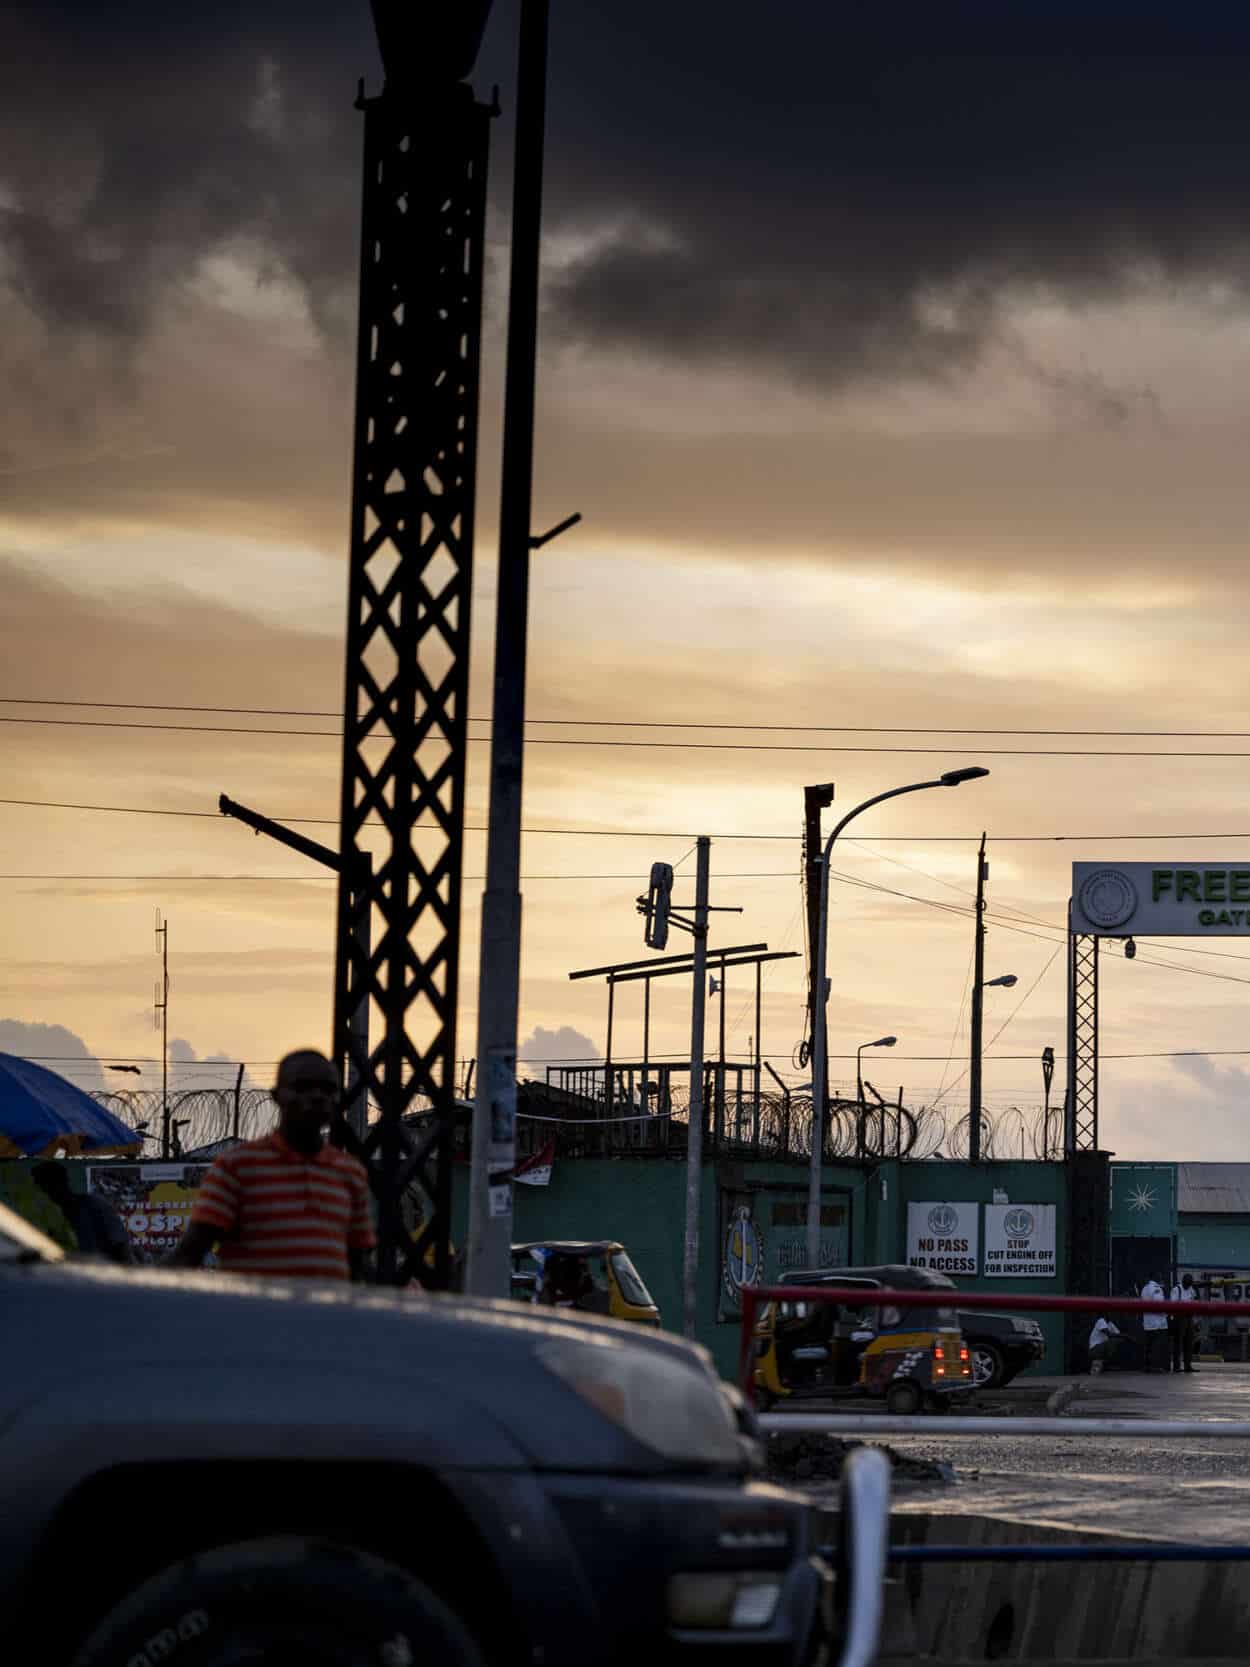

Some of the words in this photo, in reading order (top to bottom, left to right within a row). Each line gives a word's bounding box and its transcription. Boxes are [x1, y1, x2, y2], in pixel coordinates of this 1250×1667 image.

[121, 1214, 191, 1232] OSP
[918, 1238, 934, 1252] NO
[937, 1239, 969, 1251] PASS
[1007, 1239, 1030, 1249] STOP
[987, 1250, 1004, 1260] CUT
[1006, 1250, 1036, 1260] ENGINE
[1038, 1251, 1054, 1260] OFF
[910, 1257, 928, 1270] NO
[929, 1257, 976, 1271] ACCESS
[985, 1263, 1001, 1273] FOR
[1003, 1263, 1055, 1273] INSPECTION
